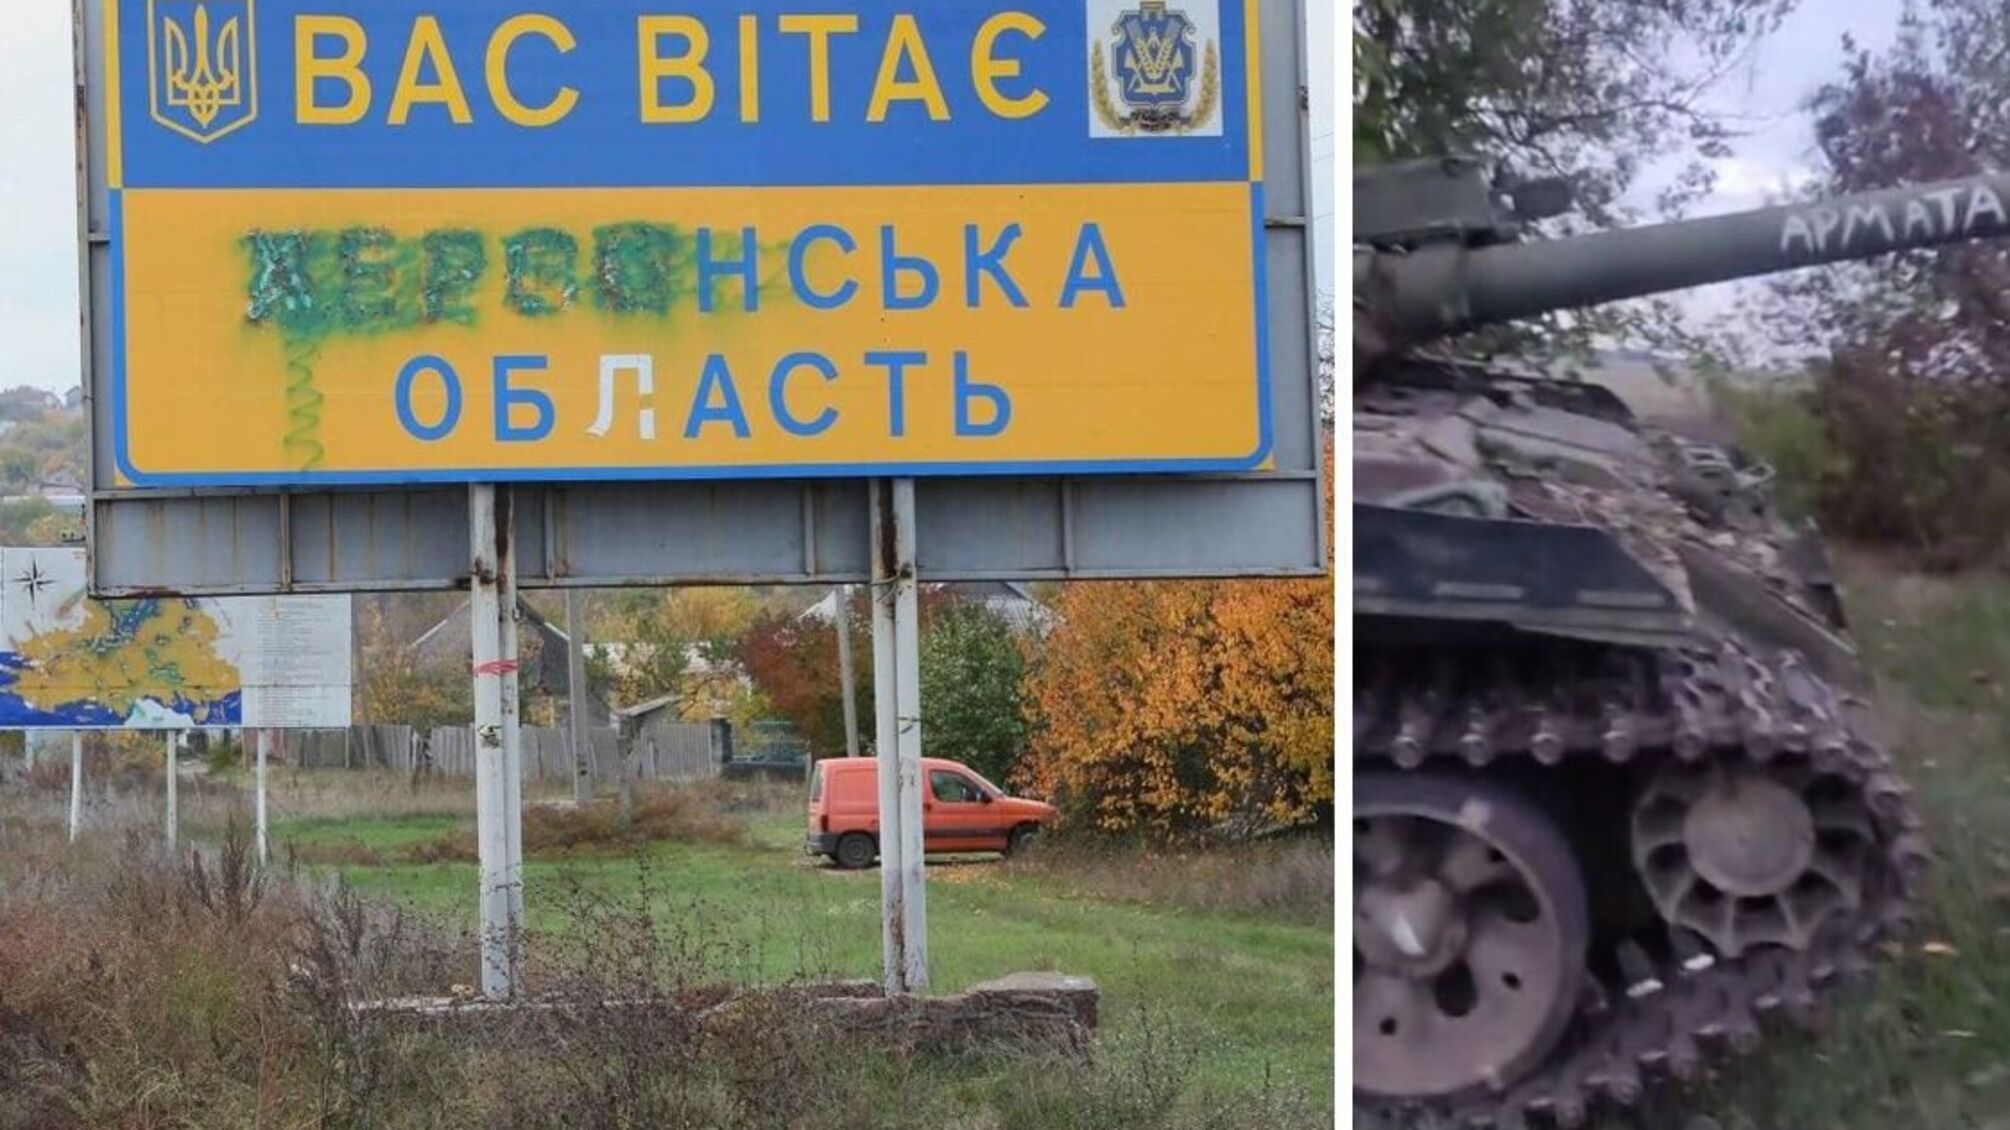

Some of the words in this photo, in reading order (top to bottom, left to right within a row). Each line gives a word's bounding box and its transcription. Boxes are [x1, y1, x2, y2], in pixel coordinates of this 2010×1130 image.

[294, 14, 580, 127] ВАС
[638, 11, 1050, 124] ВІТАЄ
[1781, 184, 2006, 253] АРМАТА
[394, 352, 1012, 440] ОБЛАСТЬ
